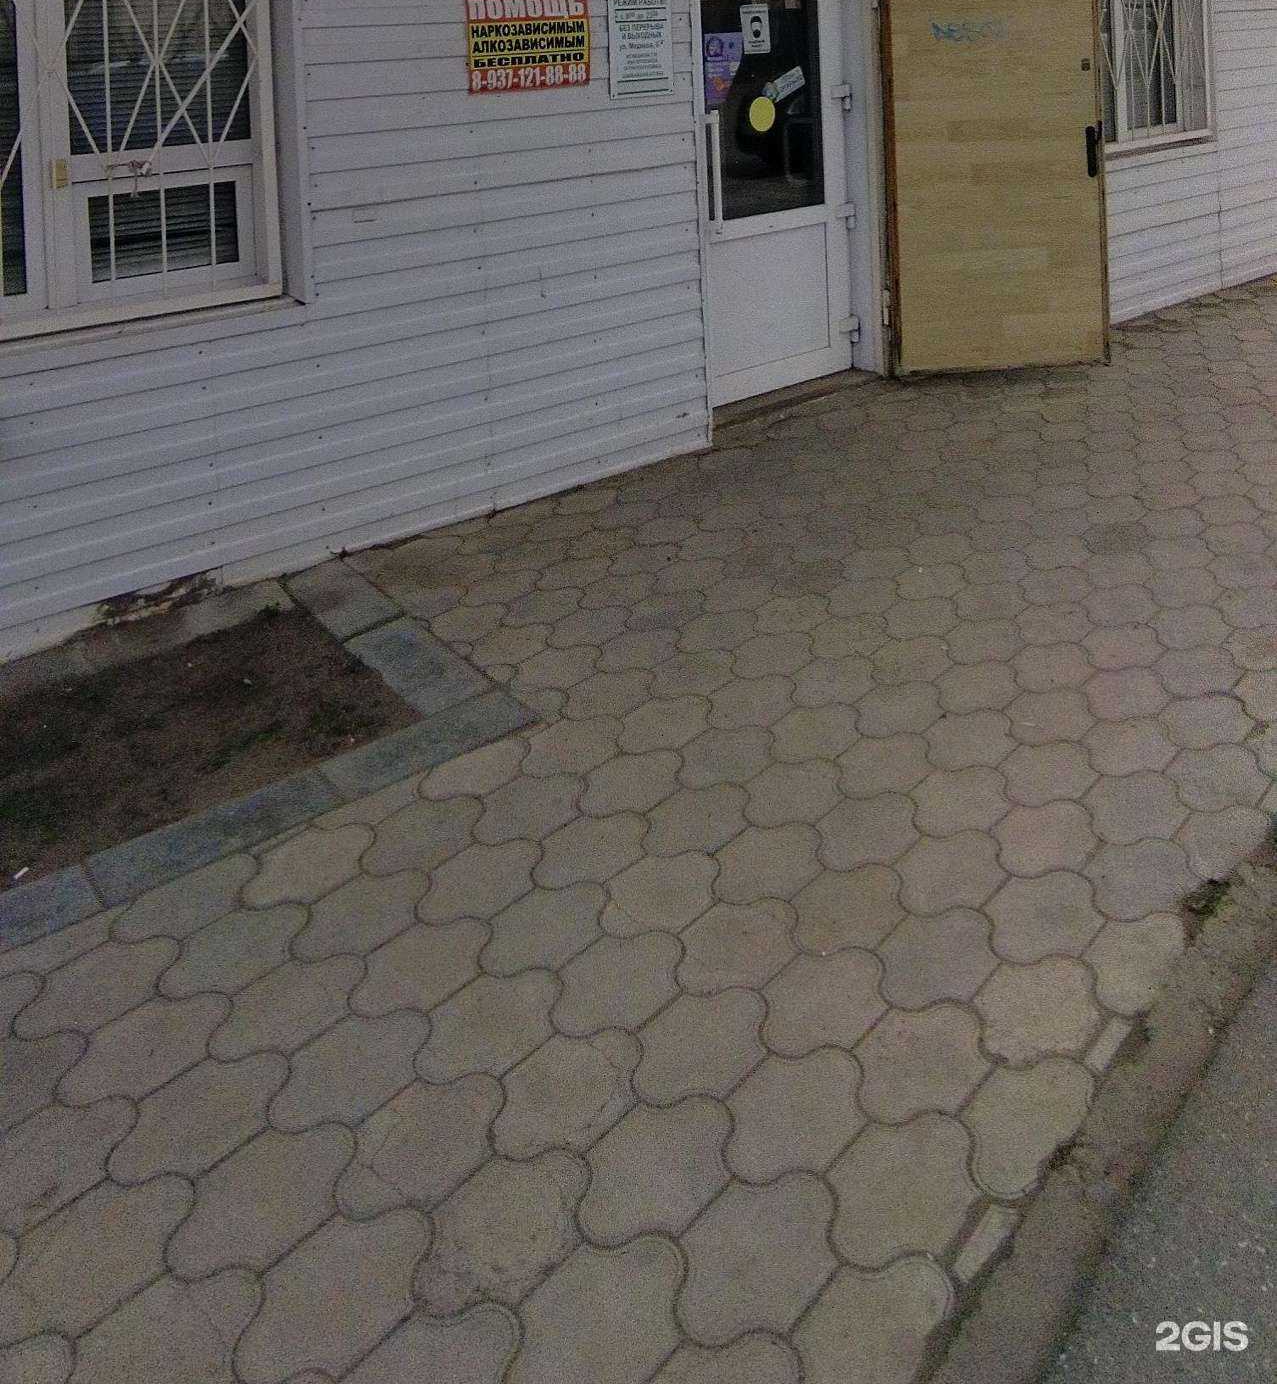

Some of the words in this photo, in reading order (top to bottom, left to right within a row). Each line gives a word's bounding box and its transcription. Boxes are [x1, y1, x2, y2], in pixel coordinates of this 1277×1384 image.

[471, 21, 584, 38] НАРКОЗАВИСИМЫМ
[472, 35, 585, 54] АЛКОЗАВИСИМЫМ
[473, 52, 584, 68] БЕСПЛАТНО
[472, 65, 586, 90] 8-937-121-88-88
